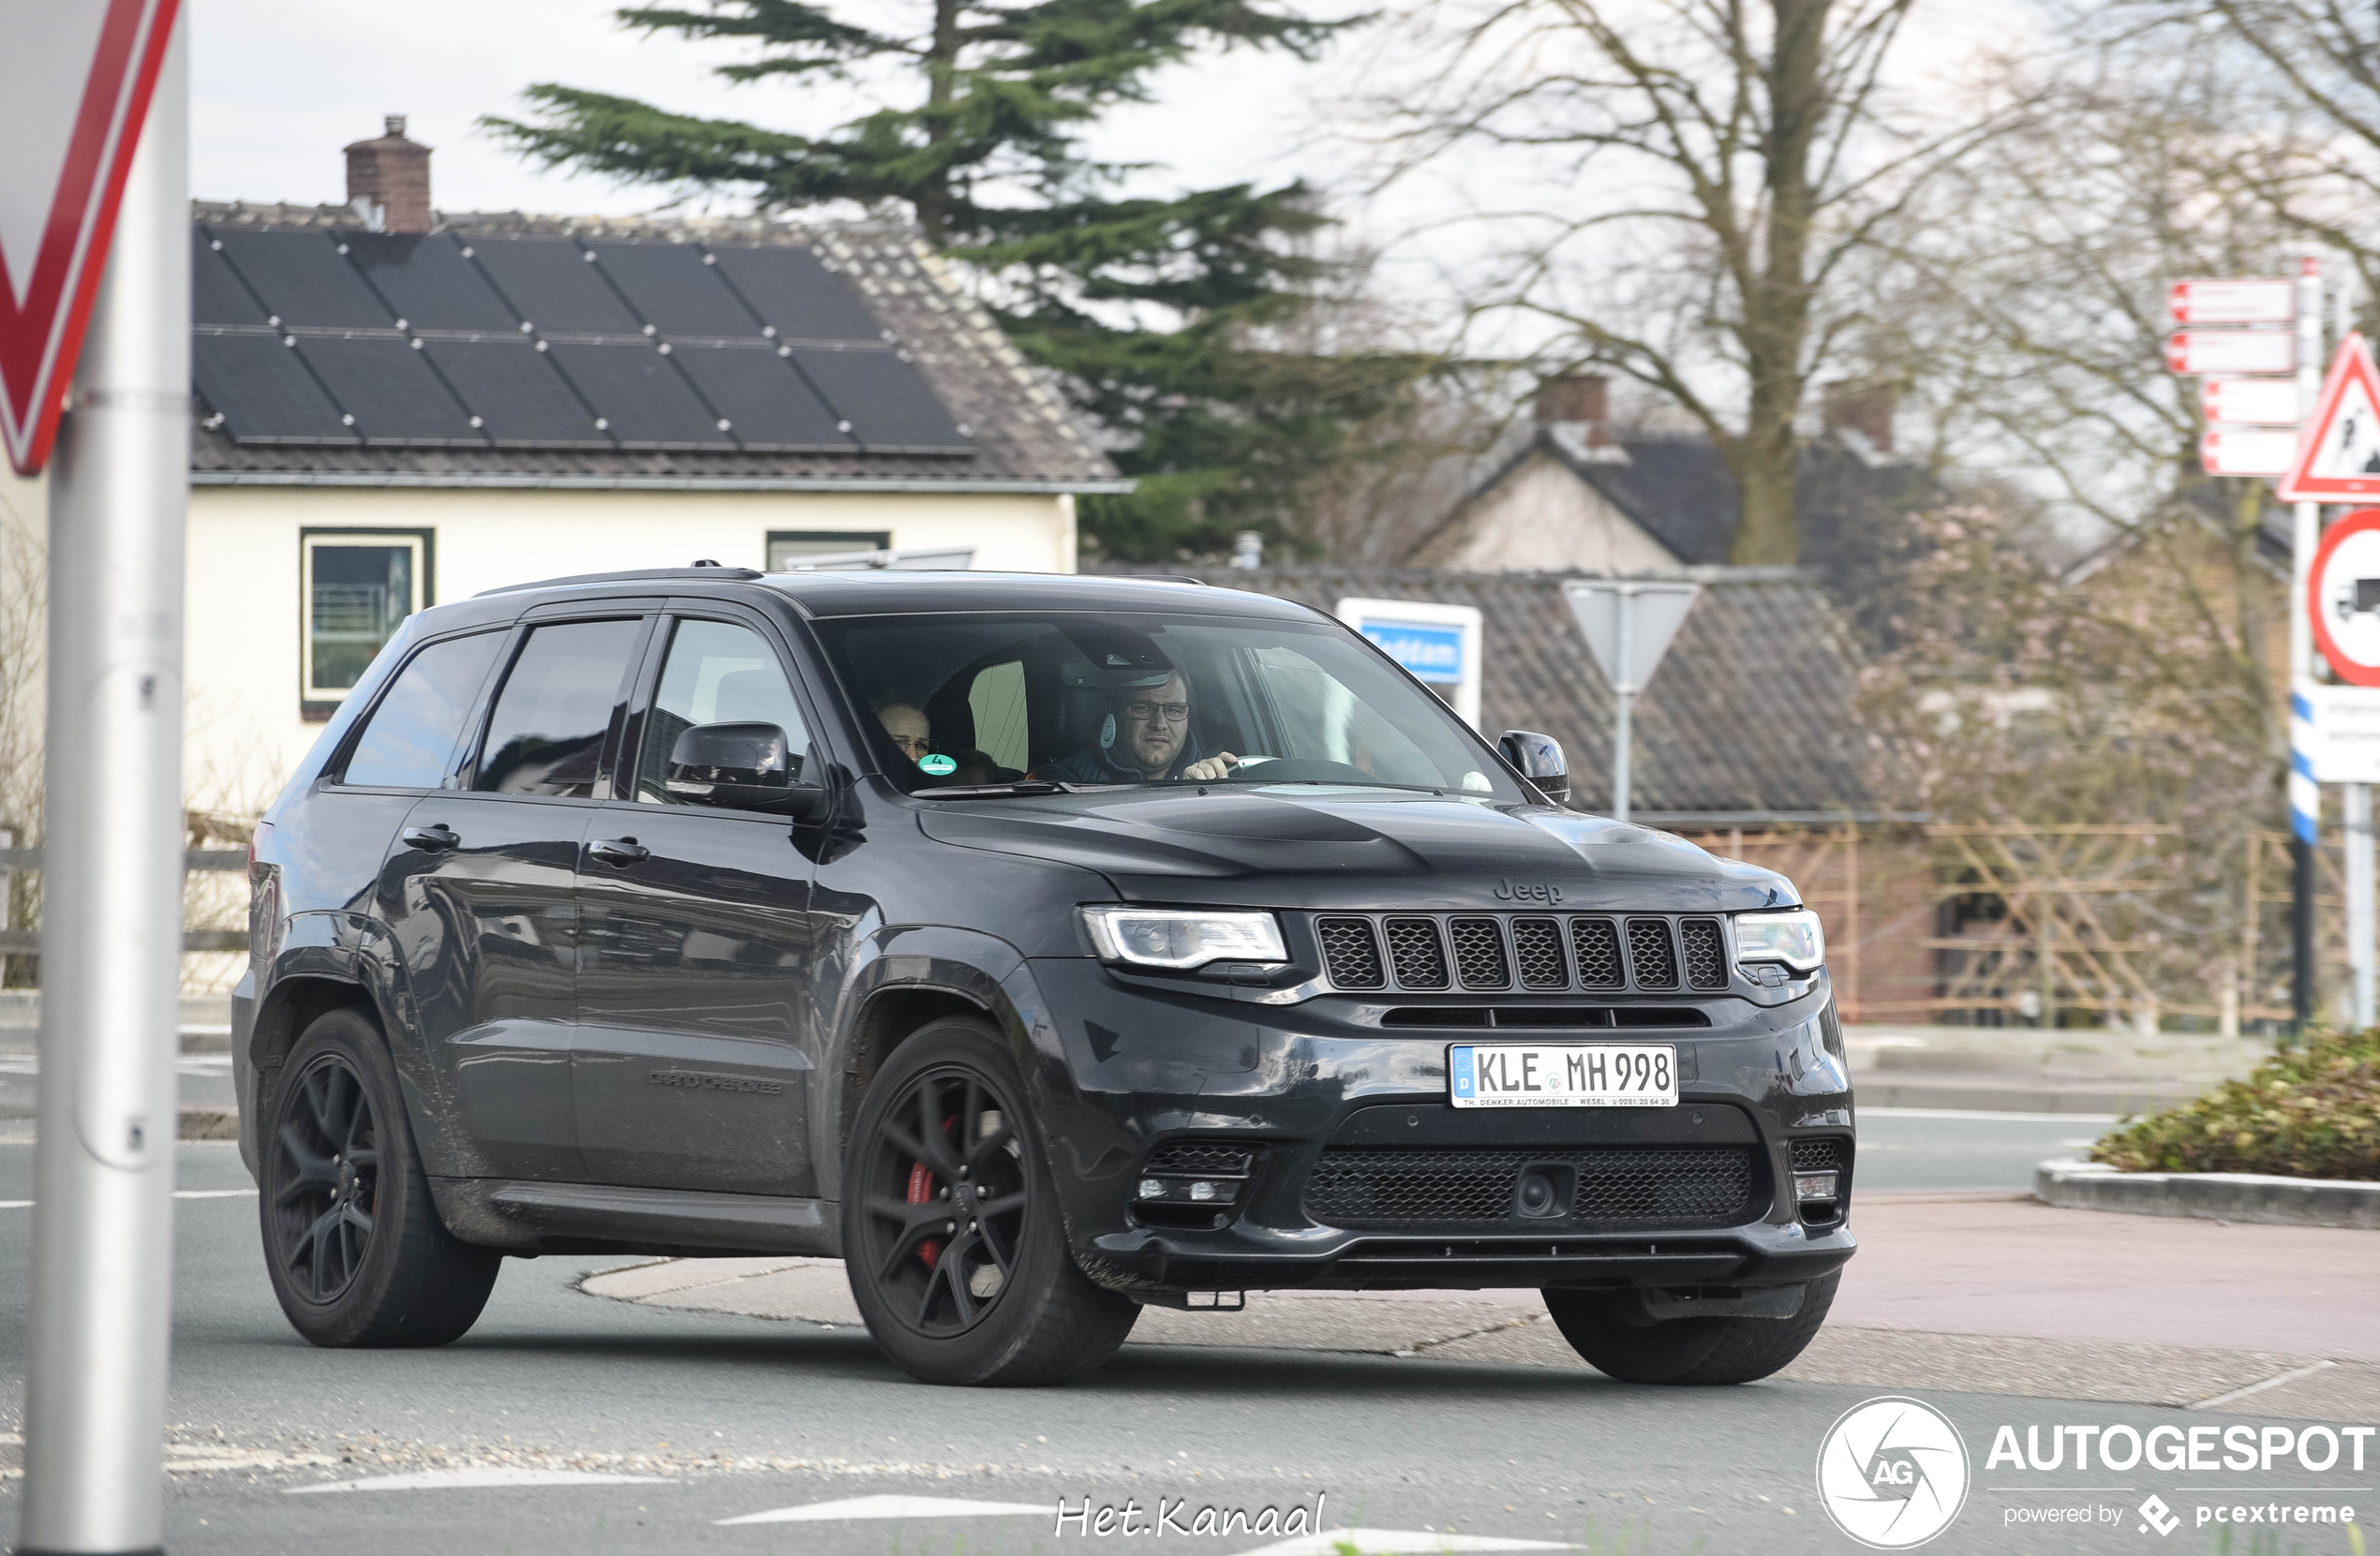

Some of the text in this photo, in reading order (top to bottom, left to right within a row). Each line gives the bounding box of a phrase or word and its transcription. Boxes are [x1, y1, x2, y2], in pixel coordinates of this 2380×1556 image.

[931, 754, 943, 764] 4
[1494, 878, 1564, 906] Jeep
[1478, 1053, 1670, 1091] KLE MH 998
[1460, 1078, 1469, 1089] D
